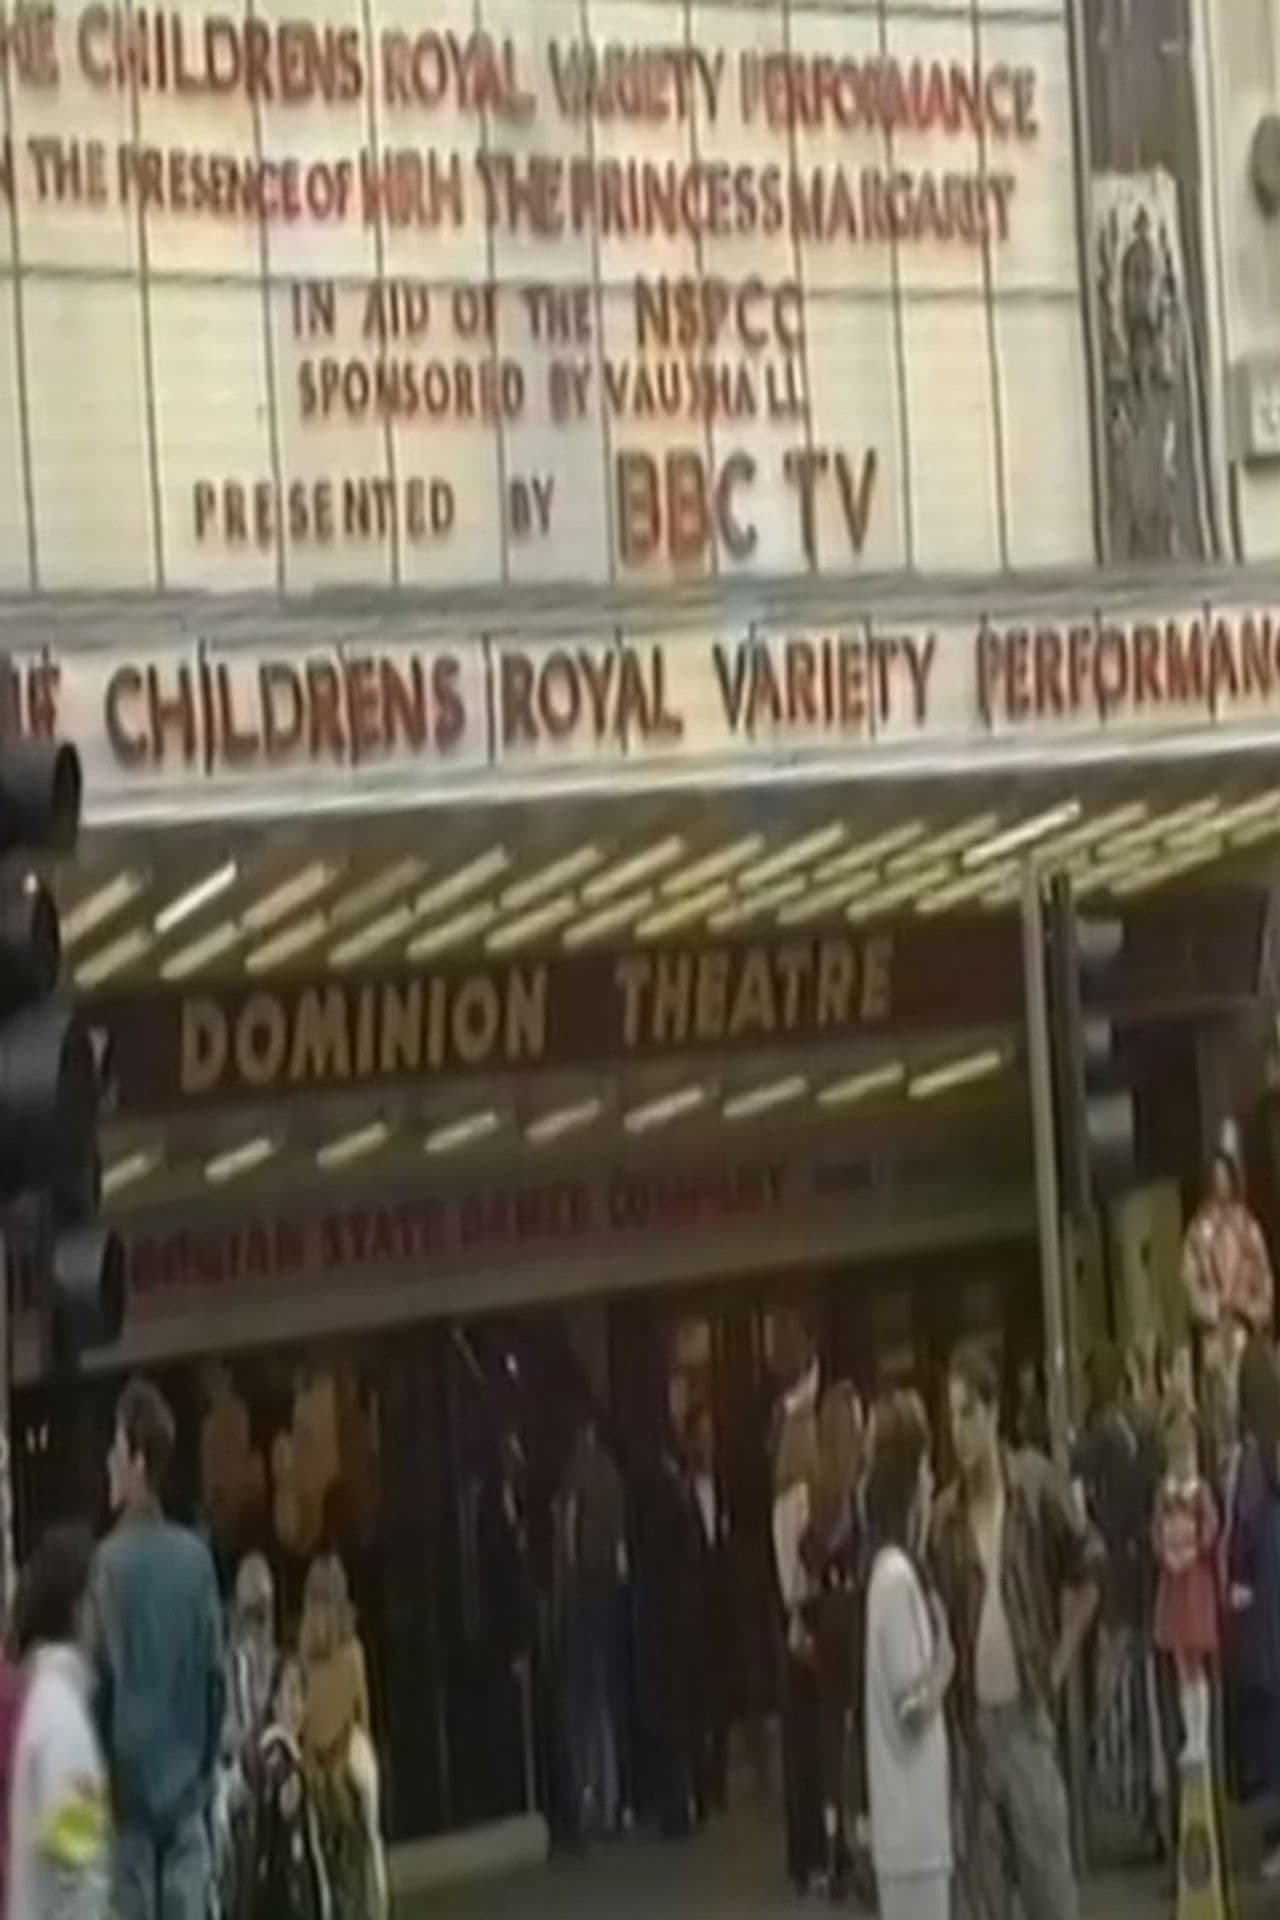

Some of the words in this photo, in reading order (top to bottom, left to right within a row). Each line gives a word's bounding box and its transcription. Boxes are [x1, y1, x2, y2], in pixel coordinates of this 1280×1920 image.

[78, 4, 363, 104] CHILDRENS
[382, 28, 536, 124] ROYAL
[27, 134, 107, 203] THE
[118, 143, 302, 219] PRESENCE
[476, 150, 563, 238] THE
[569, 158, 784, 239] PRINCESS
[293, 281, 335, 340] IN
[363, 282, 429, 345] AID
[452, 284, 497, 341] OF
[523, 284, 591, 344] THE
[635, 273, 802, 350] NSPCC
[299, 358, 524, 420] SPONSORED
[547, 360, 591, 423] BY
[603, 358, 804, 419] VAUXHALL
[194, 478, 455, 548] PRESENTED
[508, 475, 555, 538] BY
[617, 447, 757, 568] BBC
[784, 447, 877, 565] TV
[105, 652, 466, 772] CHILDRENS
[502, 643, 683, 750] ROYAL
[713, 632, 936, 738] VARIETY
[976, 610, 1280, 730] PERFORMAN
[181, 963, 549, 1092] DOMINION
[614, 939, 896, 1046] THEATRE
